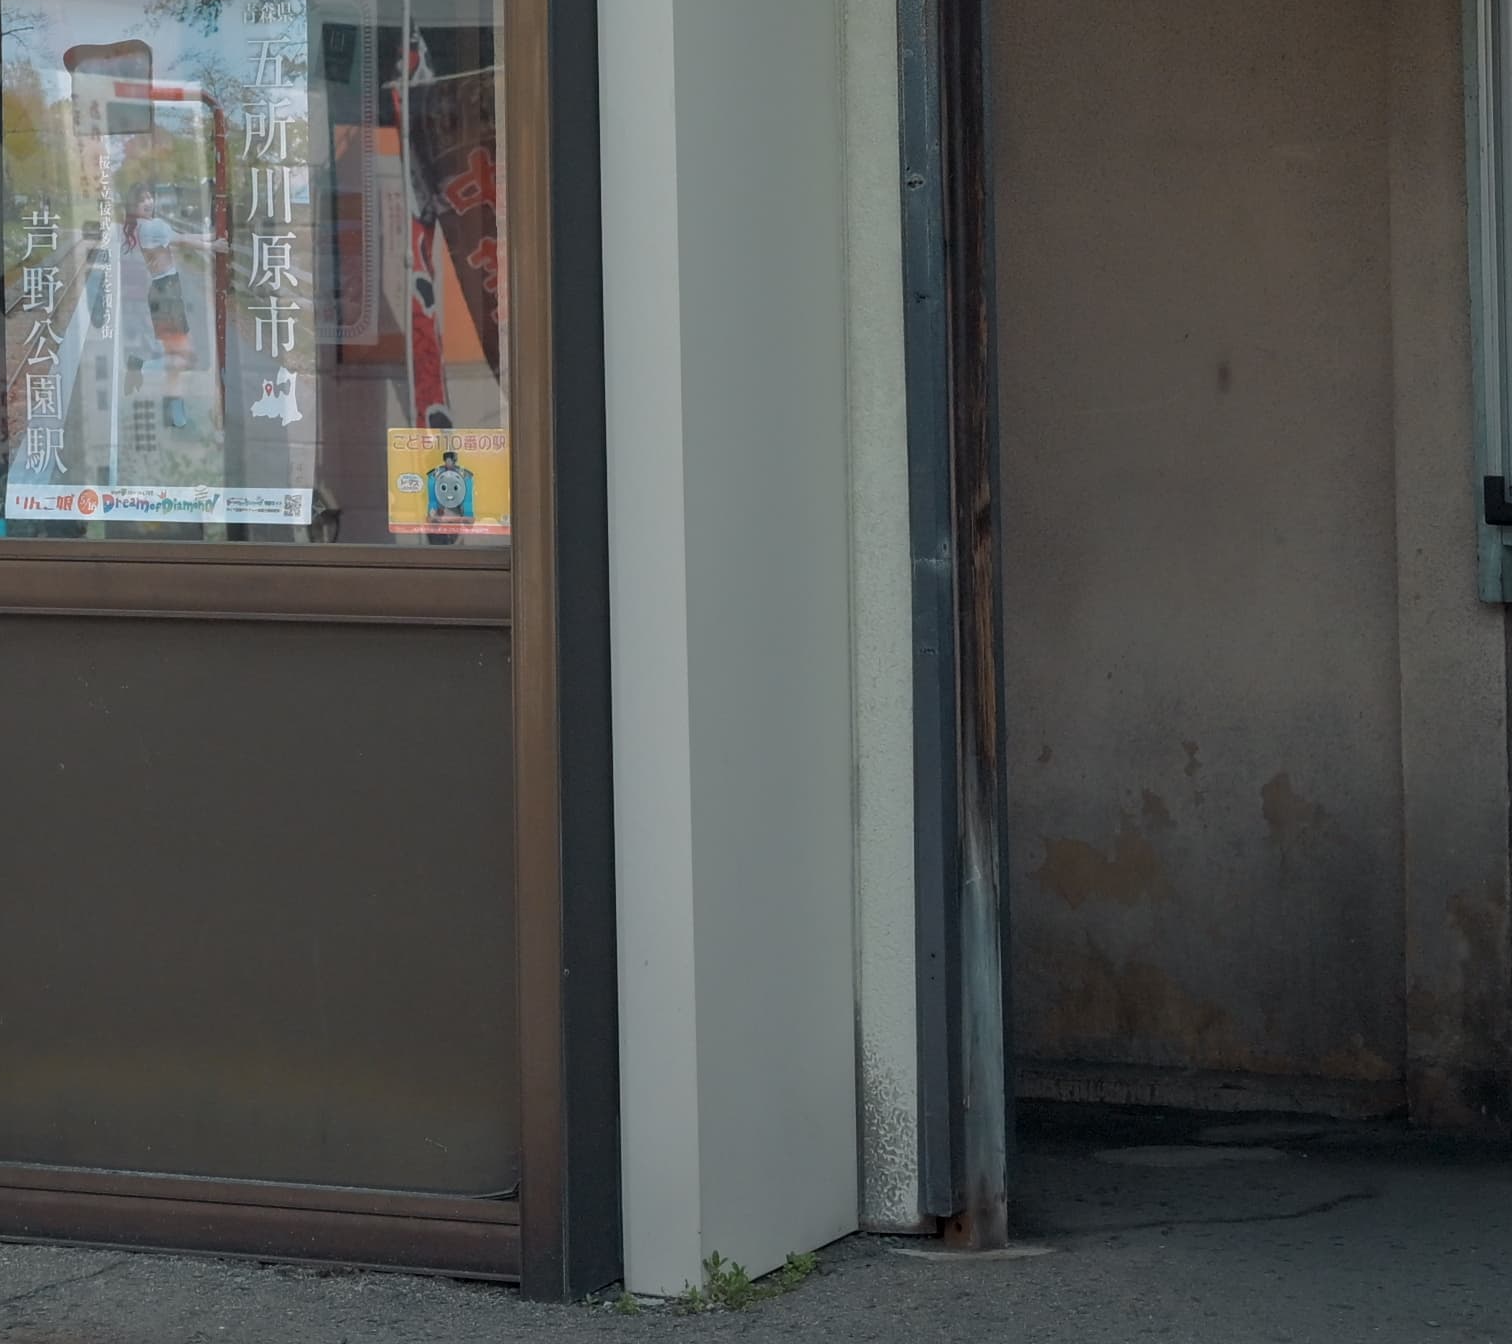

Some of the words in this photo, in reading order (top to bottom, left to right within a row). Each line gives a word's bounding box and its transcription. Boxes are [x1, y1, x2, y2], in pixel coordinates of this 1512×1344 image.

[241, 3, 293, 24] 青森県
[242, 37, 300, 357] 五所川原市
[22, 211, 68, 475] 芦野公園駅
[392, 435, 506, 451] こども110番の駅
